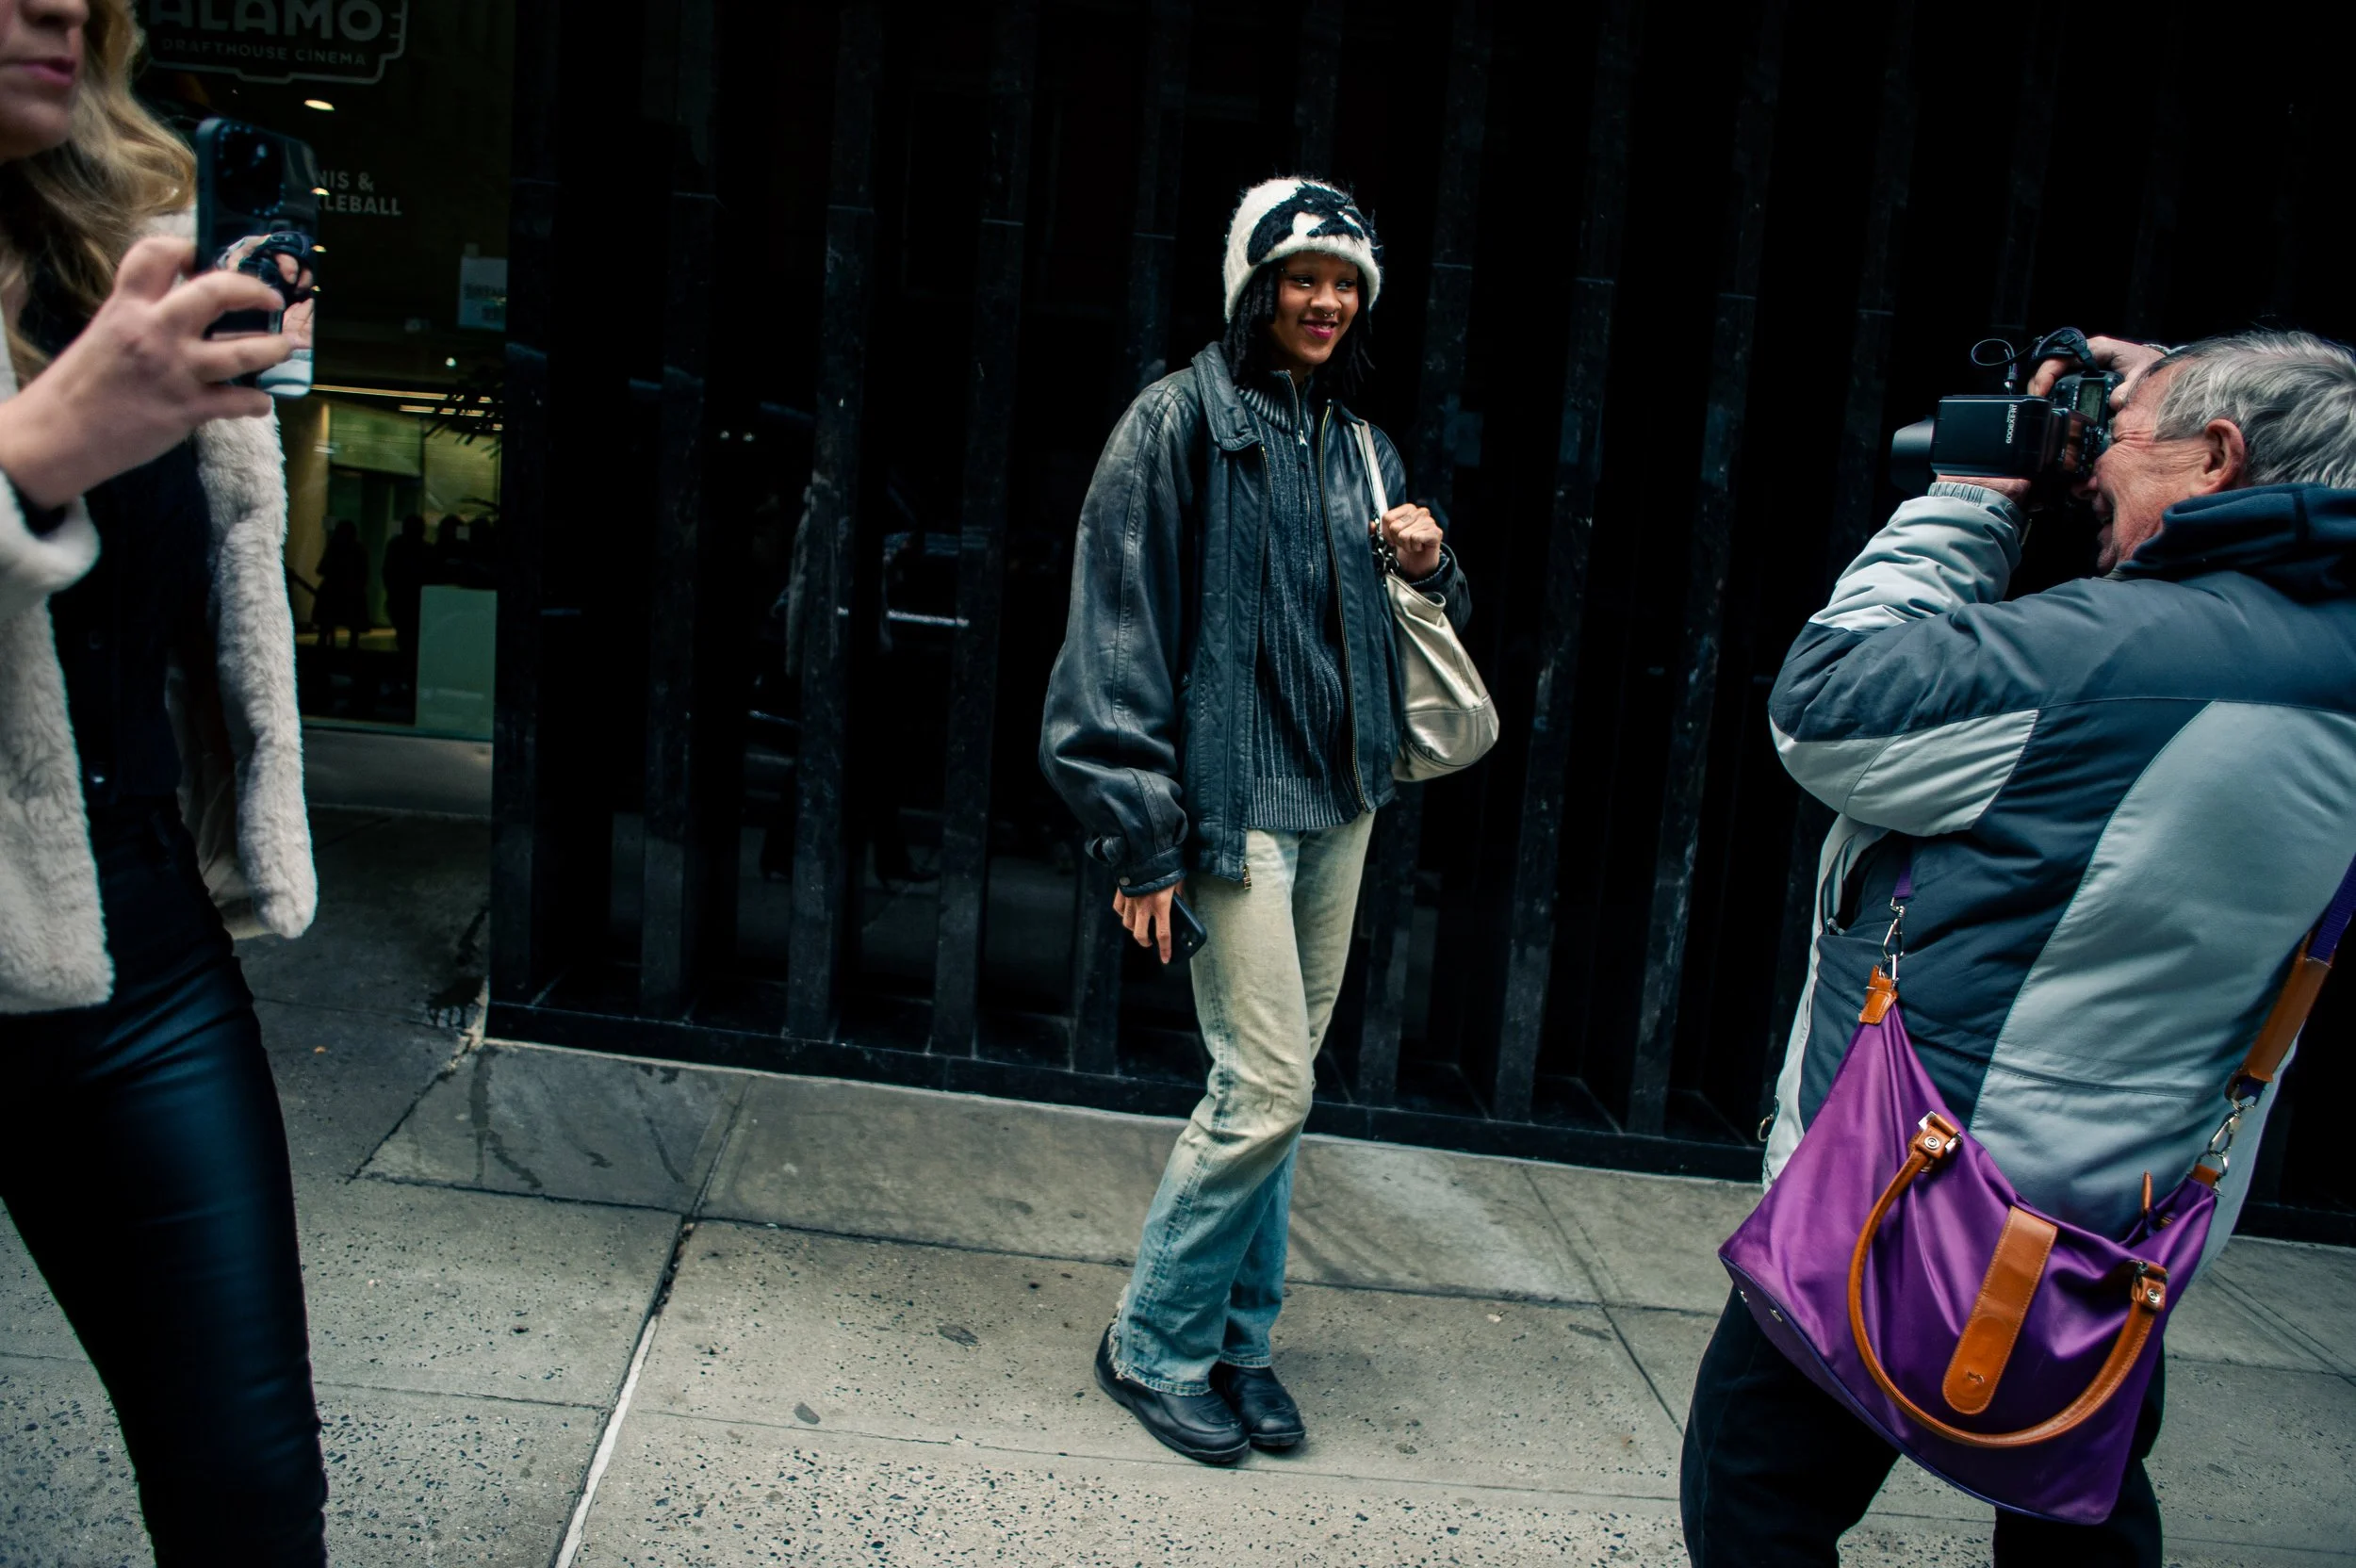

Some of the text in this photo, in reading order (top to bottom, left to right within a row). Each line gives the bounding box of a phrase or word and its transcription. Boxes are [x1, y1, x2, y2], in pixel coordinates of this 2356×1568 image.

[148, 0, 384, 41] ALAMO
[160, 38, 367, 66] DRAFTHOUSE CINEMA
[357, 171, 375, 192] &
[318, 193, 403, 217] LEBALL
